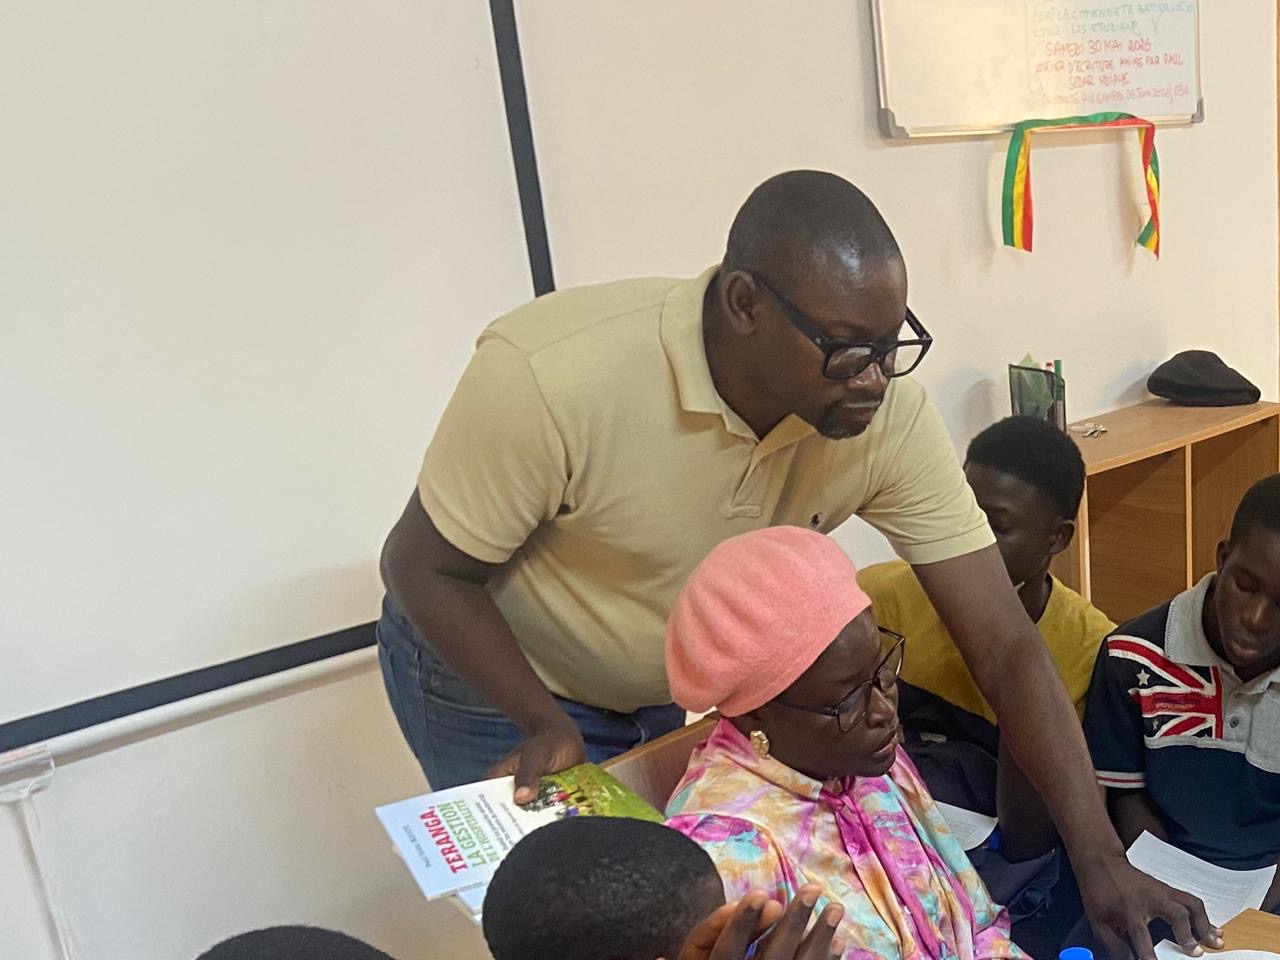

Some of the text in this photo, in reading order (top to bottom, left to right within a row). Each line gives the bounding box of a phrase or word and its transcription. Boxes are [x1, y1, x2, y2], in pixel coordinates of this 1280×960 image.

[1088, 39, 1102, 55] 30
[420, 805, 469, 874] TERANGA,
[436, 802, 477, 850] GESTION
[467, 850, 487, 867] LA
